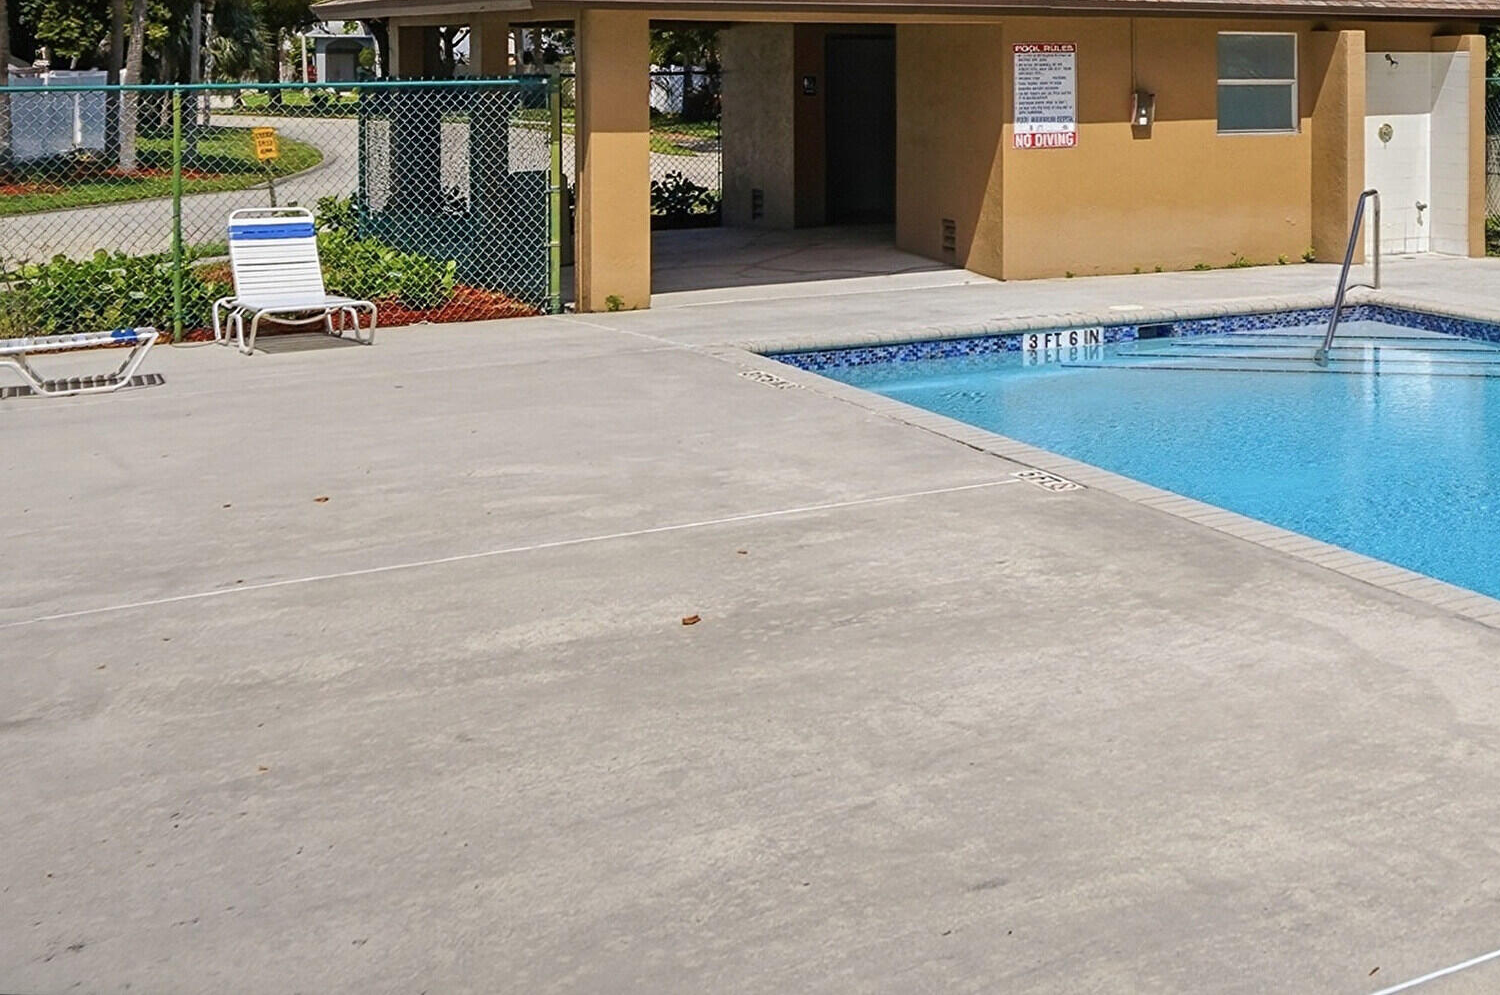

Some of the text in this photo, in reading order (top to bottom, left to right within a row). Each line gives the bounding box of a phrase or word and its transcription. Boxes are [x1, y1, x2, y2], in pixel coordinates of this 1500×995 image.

[1014, 45, 1040, 53] POOL
[1015, 132, 1074, 147] NO DIVING
[1029, 329, 1099, 349] 3 FT 6 IN
